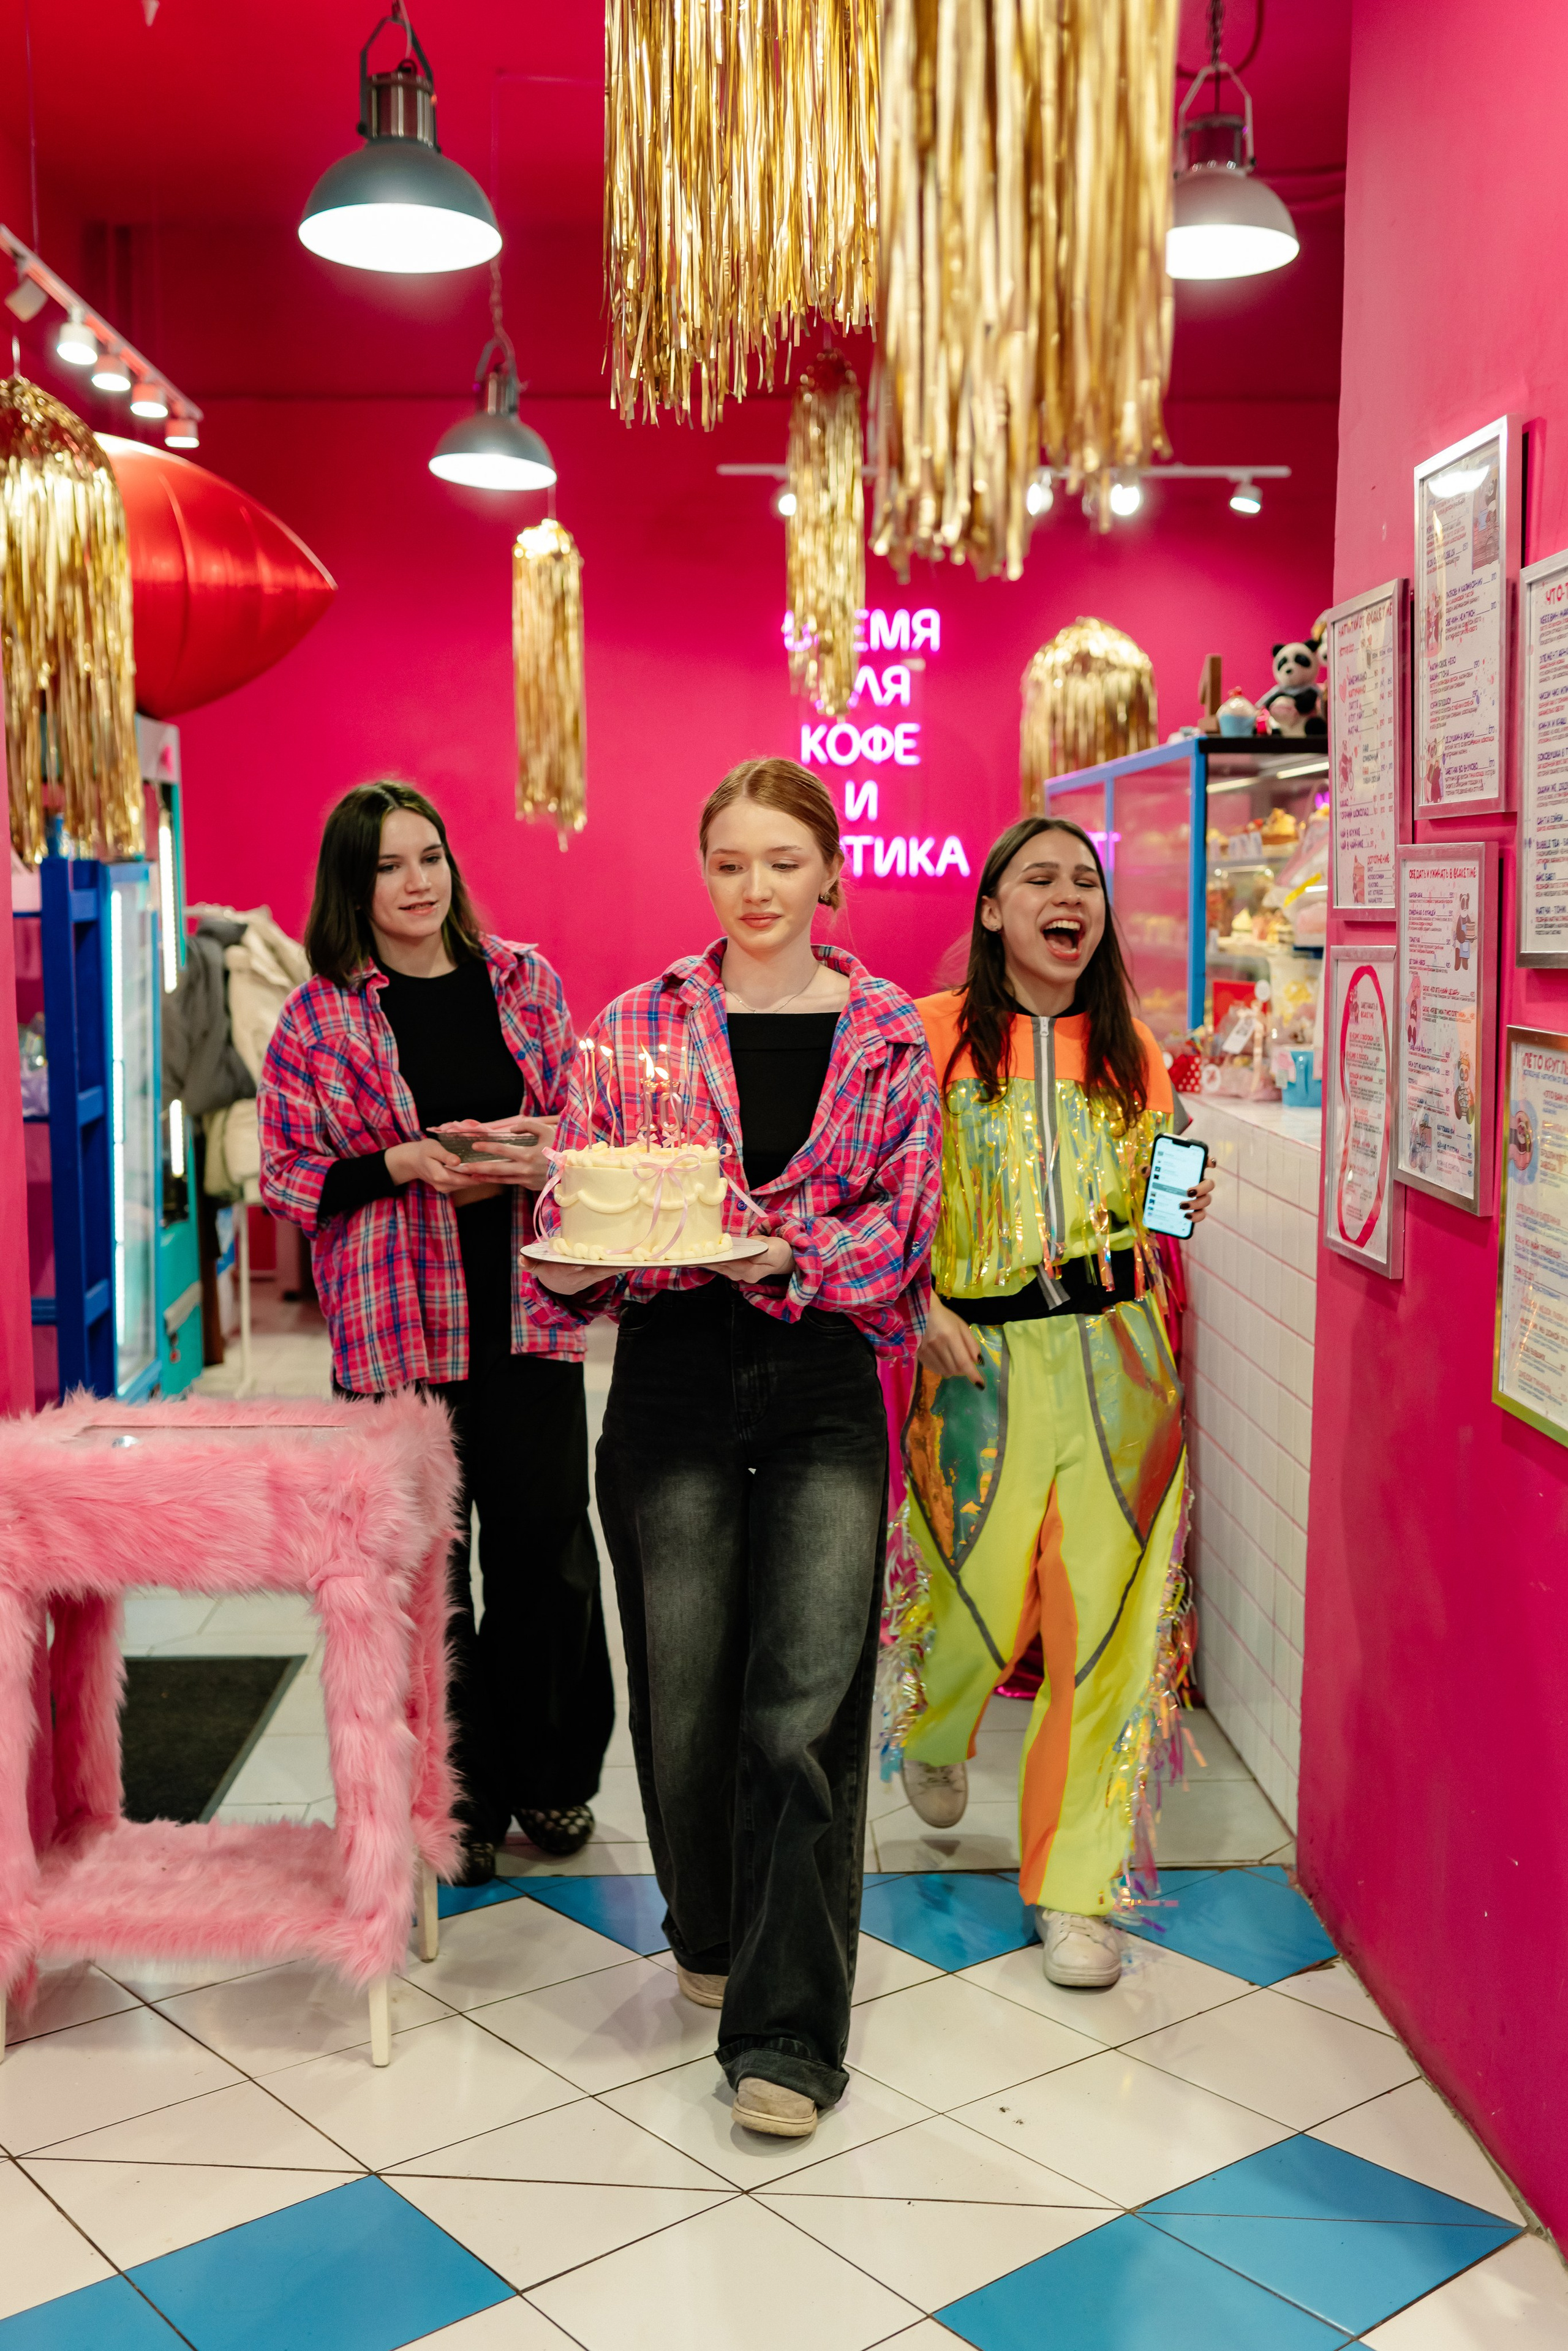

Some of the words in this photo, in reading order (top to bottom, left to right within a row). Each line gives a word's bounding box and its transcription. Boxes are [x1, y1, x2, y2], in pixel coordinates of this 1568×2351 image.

[784, 608, 941, 652] ЕМЯ
[801, 722, 921, 766] КОФЕ
[845, 780, 878, 821] И
[840, 835, 970, 877] ТИКА
[1409, 869, 1426, 879] ОБЕДАТЬ
[1430, 869, 1449, 878] УЖИНАТЬ
